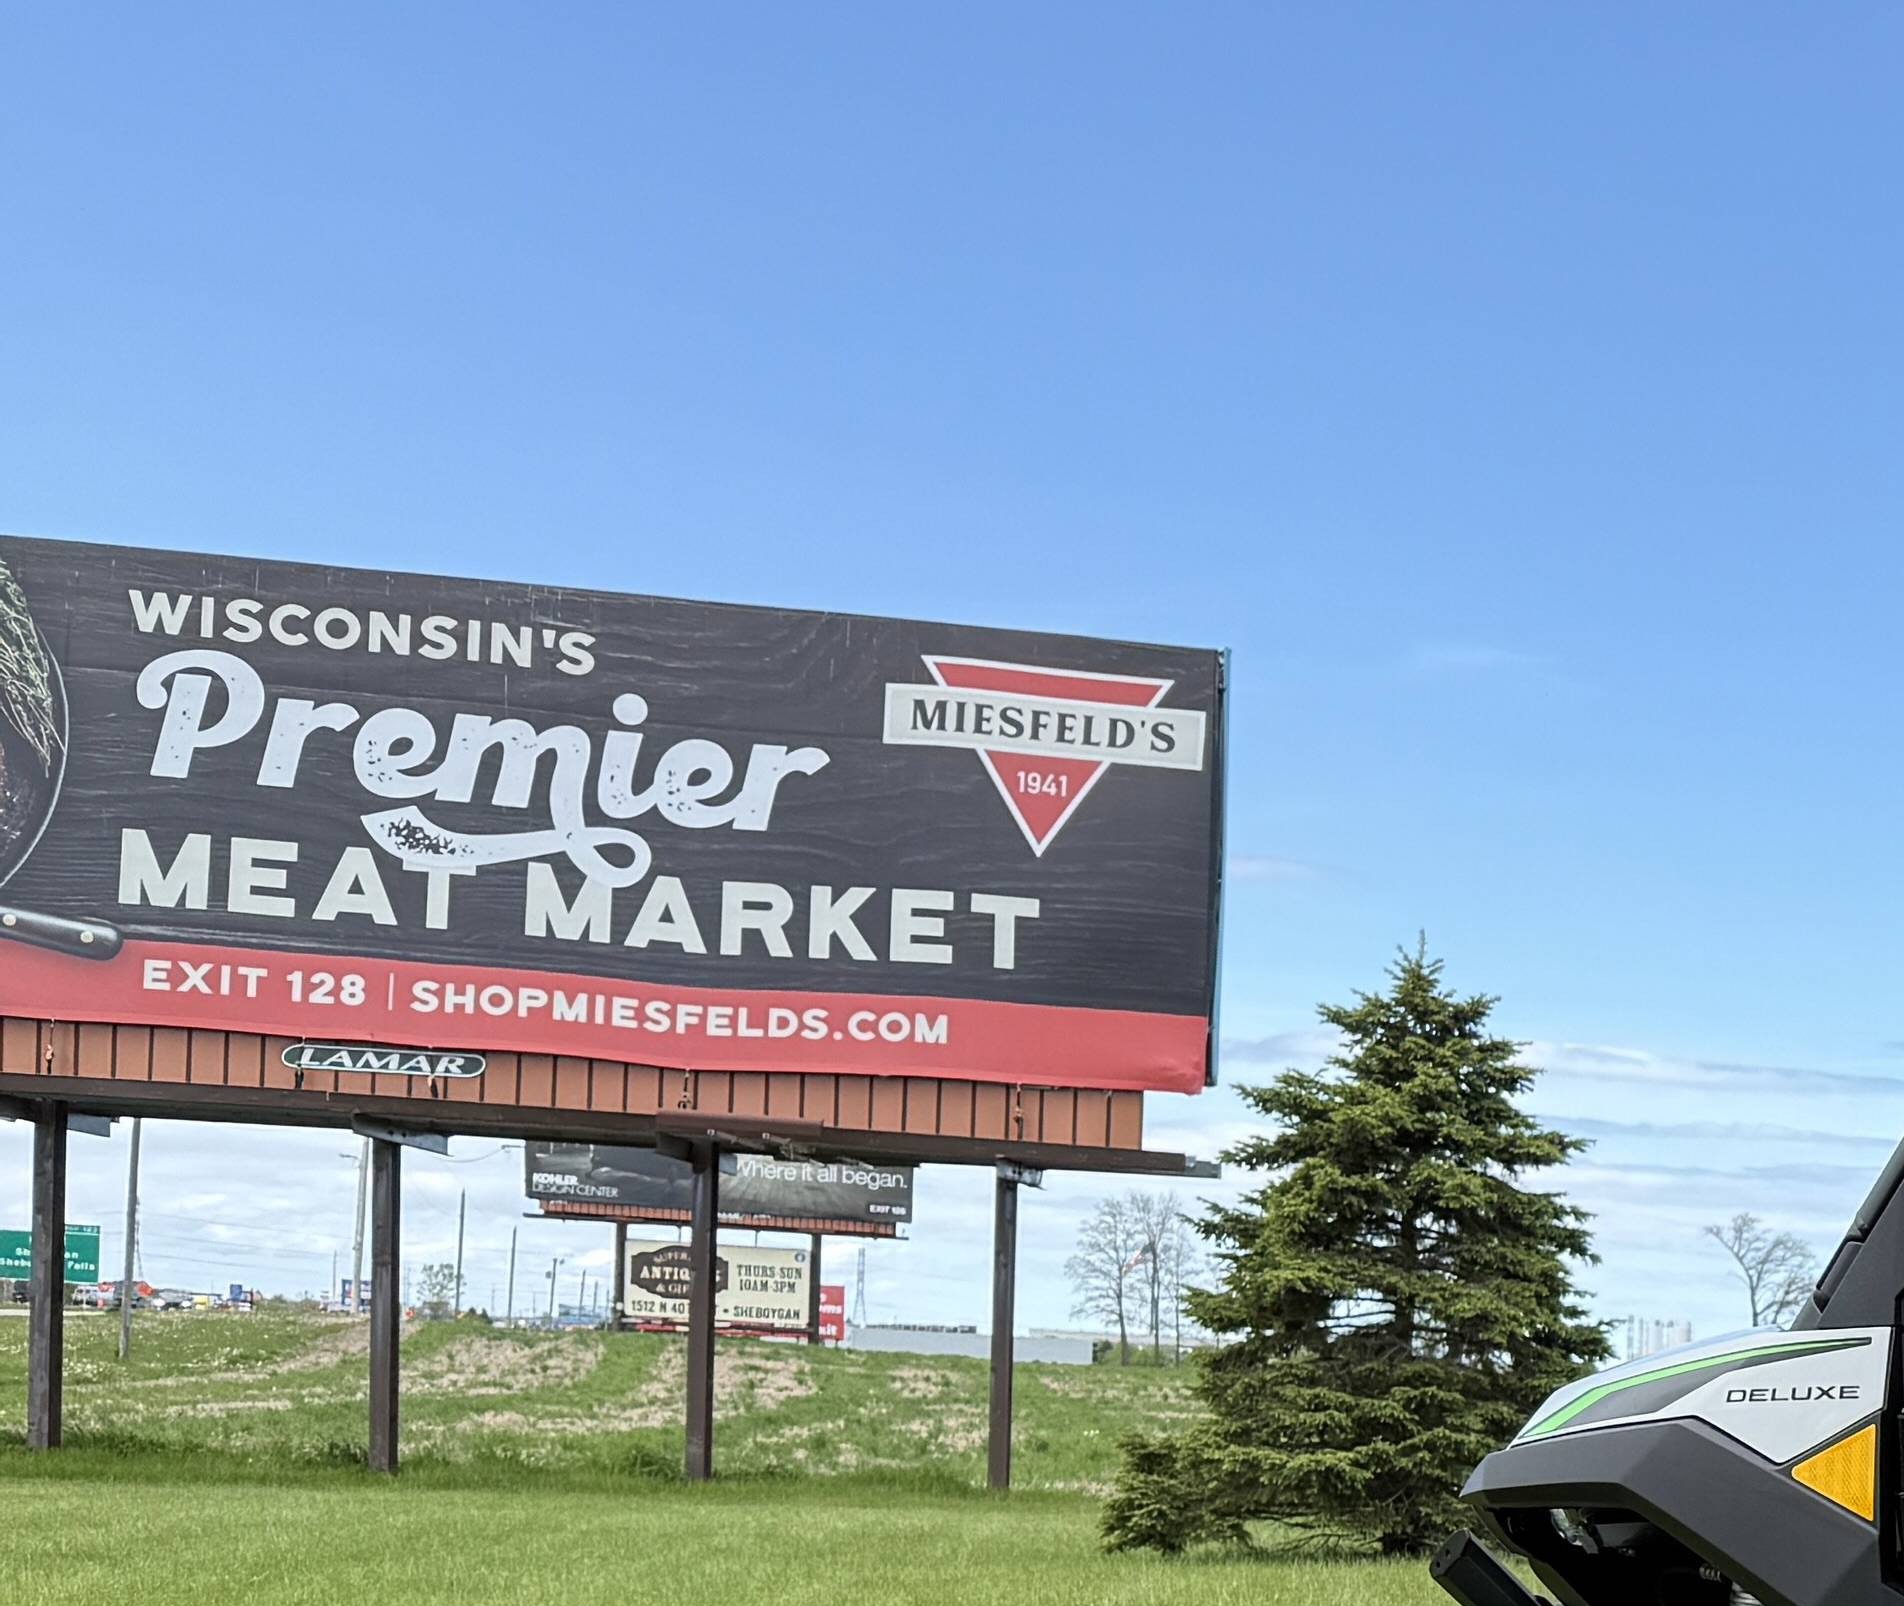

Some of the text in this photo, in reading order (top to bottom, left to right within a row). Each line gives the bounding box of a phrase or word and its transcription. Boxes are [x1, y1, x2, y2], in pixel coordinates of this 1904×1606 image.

[128, 589, 596, 676] WISCONSIN'S
[910, 698, 1177, 754] MIESFELD'S
[136, 648, 831, 888] Premier
[1016, 771, 1068, 797] 1941
[118, 827, 1040, 970] MEAT MARKET
[143, 958, 949, 1044] EXIT 128 SHOPMIESFELDS.COM
[295, 1048, 466, 1074] LAMAR
[532, 1172, 579, 1185] KOHLER
[801, 1163, 814, 1182] it
[816, 1165, 838, 1183] all
[841, 1166, 908, 1190] began.
[532, 1184, 619, 1197] DESIGN CENTER
[631, 1300, 655, 1313] 1512
[660, 1302, 667, 1313] N
[733, 1305, 801, 1320] SHEBOYGAN
[1725, 1384, 1861, 1403] DELUXE
